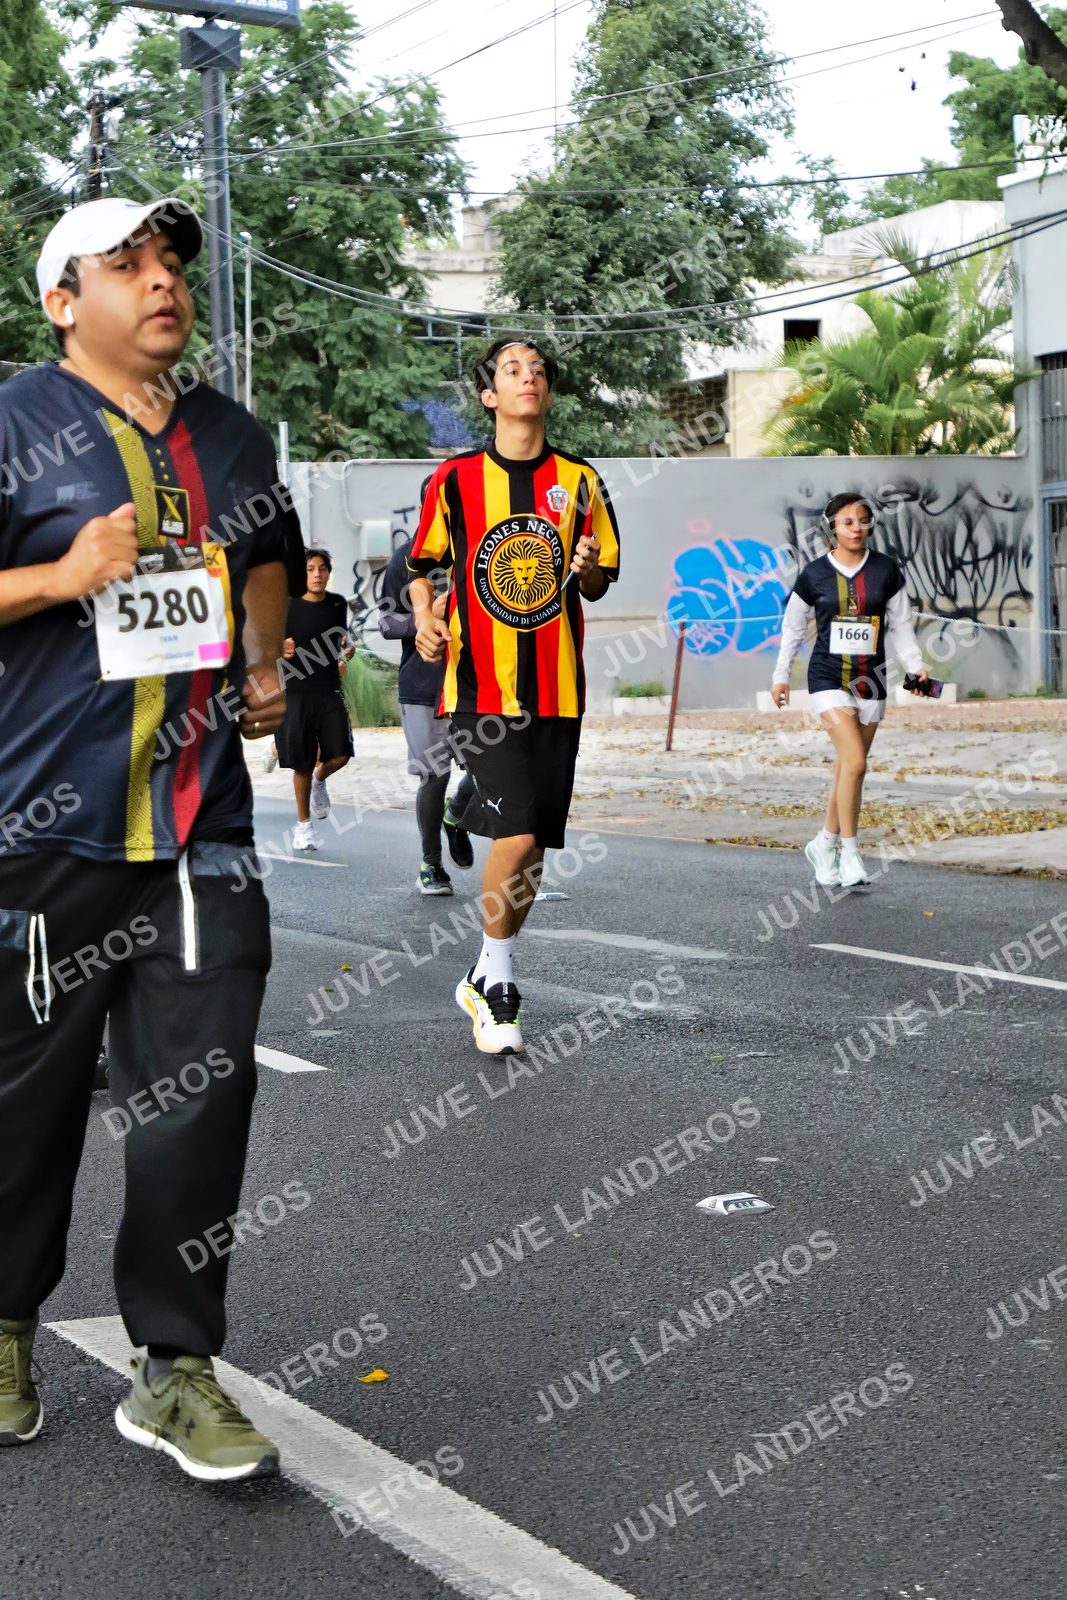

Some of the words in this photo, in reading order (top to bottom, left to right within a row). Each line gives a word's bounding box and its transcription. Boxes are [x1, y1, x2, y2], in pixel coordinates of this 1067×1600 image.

[477, 521, 520, 570] LEONES
[118, 585, 209, 633] 5280
[479, 577, 519, 623] UNIVERSIDAD
[520, 617, 530, 625] DE
[838, 627, 869, 641] 1666
